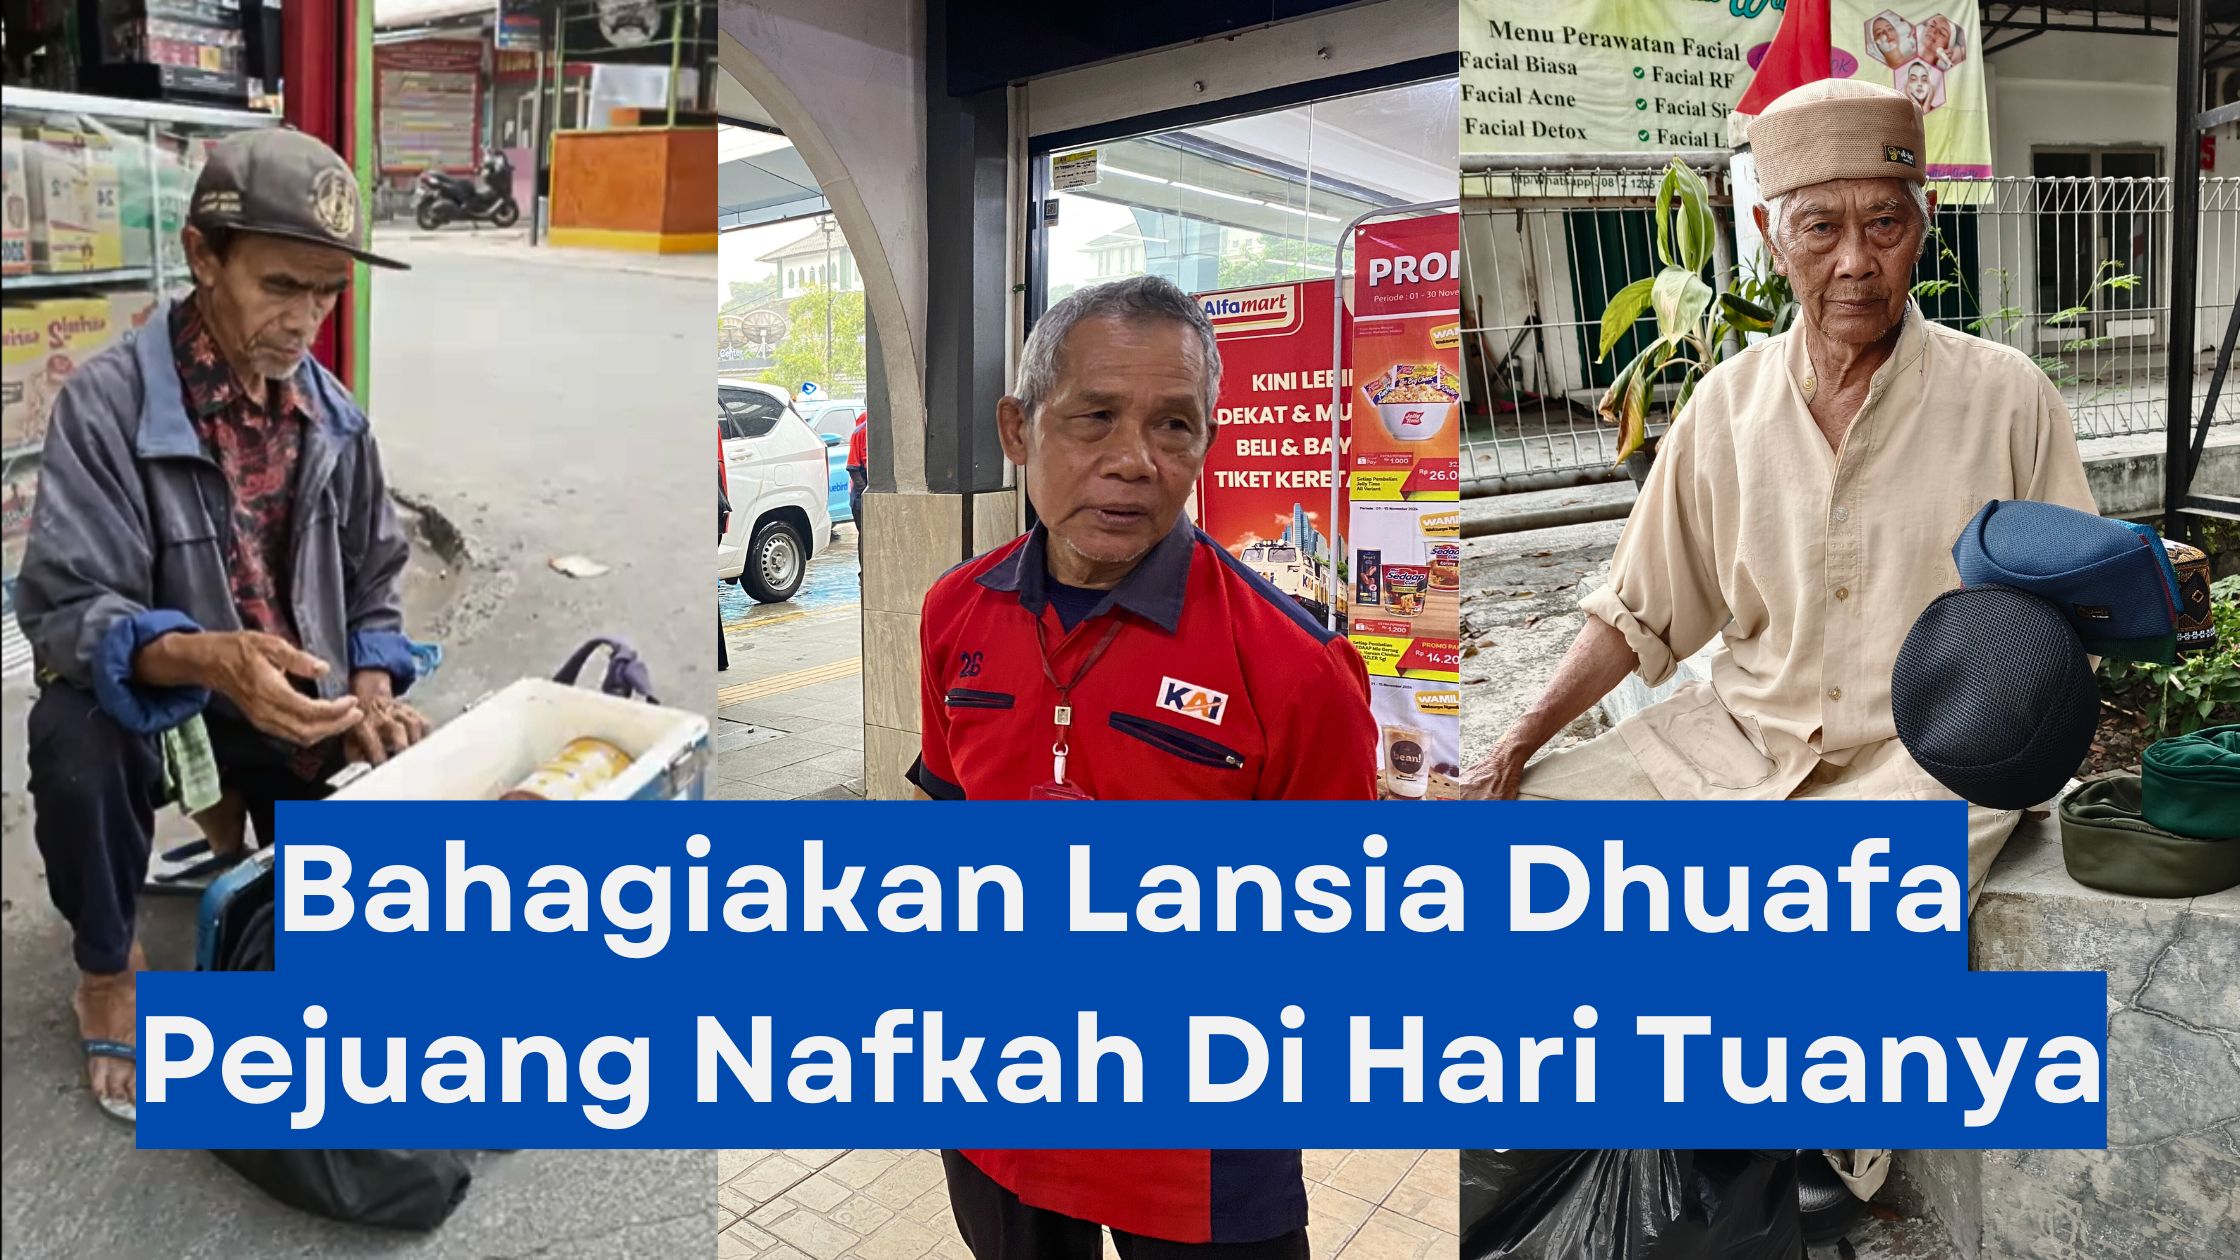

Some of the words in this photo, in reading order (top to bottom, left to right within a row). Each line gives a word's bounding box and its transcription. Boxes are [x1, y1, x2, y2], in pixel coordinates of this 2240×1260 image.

[1488, 19, 1555, 44] Menu
[1562, 25, 1675, 55] Perawatan
[1681, 37, 1741, 61] Facial
[1460, 51, 1519, 71] Facial
[1525, 54, 1578, 76] Biasa
[1652, 66, 1704, 87] Facial
[1710, 72, 1735, 89] RF
[1461, 84, 1522, 104] Facial
[1528, 88, 1576, 107] Acne
[1655, 97, 1706, 117] Facial
[1465, 117, 1525, 137] Facial
[1532, 120, 1588, 140] Detox
[1657, 129, 1708, 147] Facial
[1204, 294, 1288, 316] Alfamart
[1374, 293, 1404, 303] Periode
[1409, 292, 1419, 300] 01
[1427, 290, 1437, 298] 30
[1252, 371, 1297, 392] KINI
[1217, 405, 1289, 425] DEKAT
[1292, 404, 1312, 423] &
[1236, 438, 1277, 457] BELI
[1280, 438, 1300, 456] &
[1214, 470, 1273, 488] TIKET
[1419, 468, 1429, 476] Rp
[1429, 470, 1459, 481] 26.0
[1387, 571, 1425, 582] Sedaap
[1421, 641, 1447, 649] PROMO
[959, 652, 983, 678] 26
[1392, 752, 1422, 763] bean!
